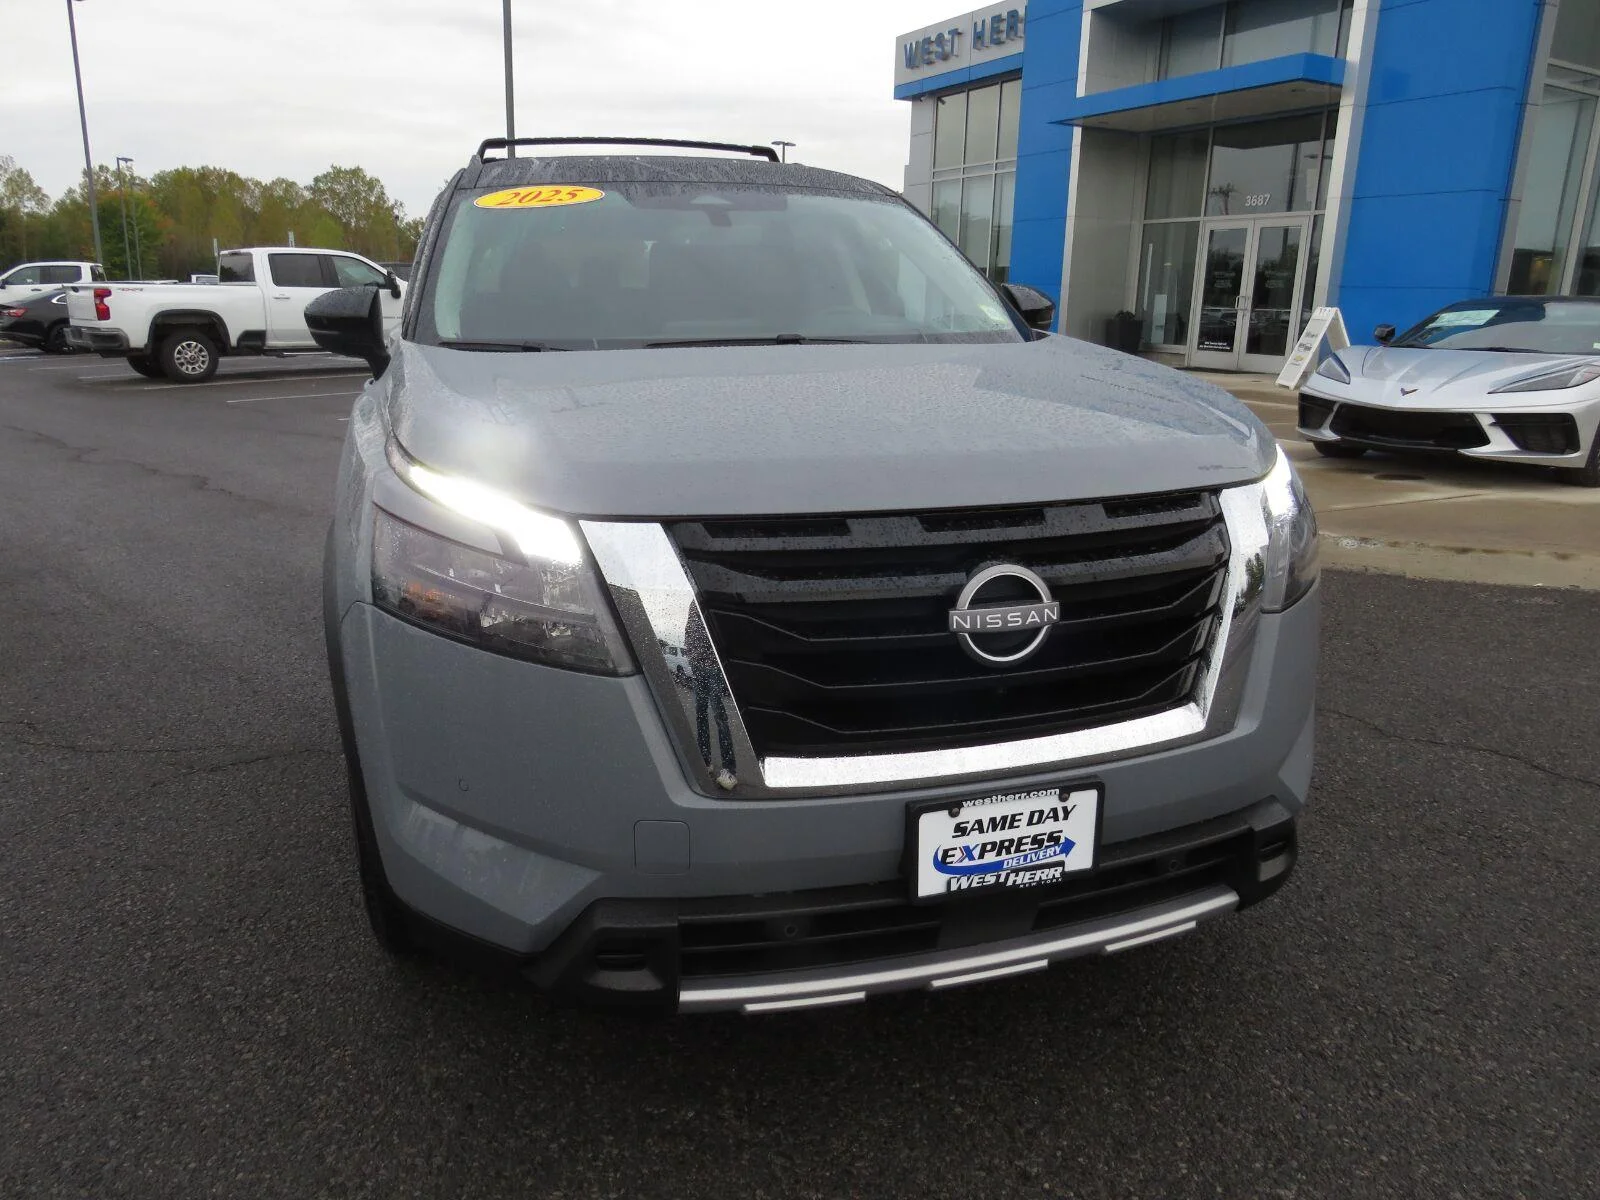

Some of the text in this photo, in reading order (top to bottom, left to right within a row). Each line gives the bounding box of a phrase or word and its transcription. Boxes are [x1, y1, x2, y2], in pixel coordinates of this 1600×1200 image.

[904, 6, 1027, 69] WEST HER
[496, 189, 583, 206] 2025
[1245, 194, 1271, 206] 3687
[953, 607, 1058, 629] NISSAN
[962, 788, 1060, 808] westherr.com
[952, 804, 1077, 838] SAME DAY
[940, 830, 1063, 865] EXPRESS
[1003, 843, 1063, 869] DELIVERY
